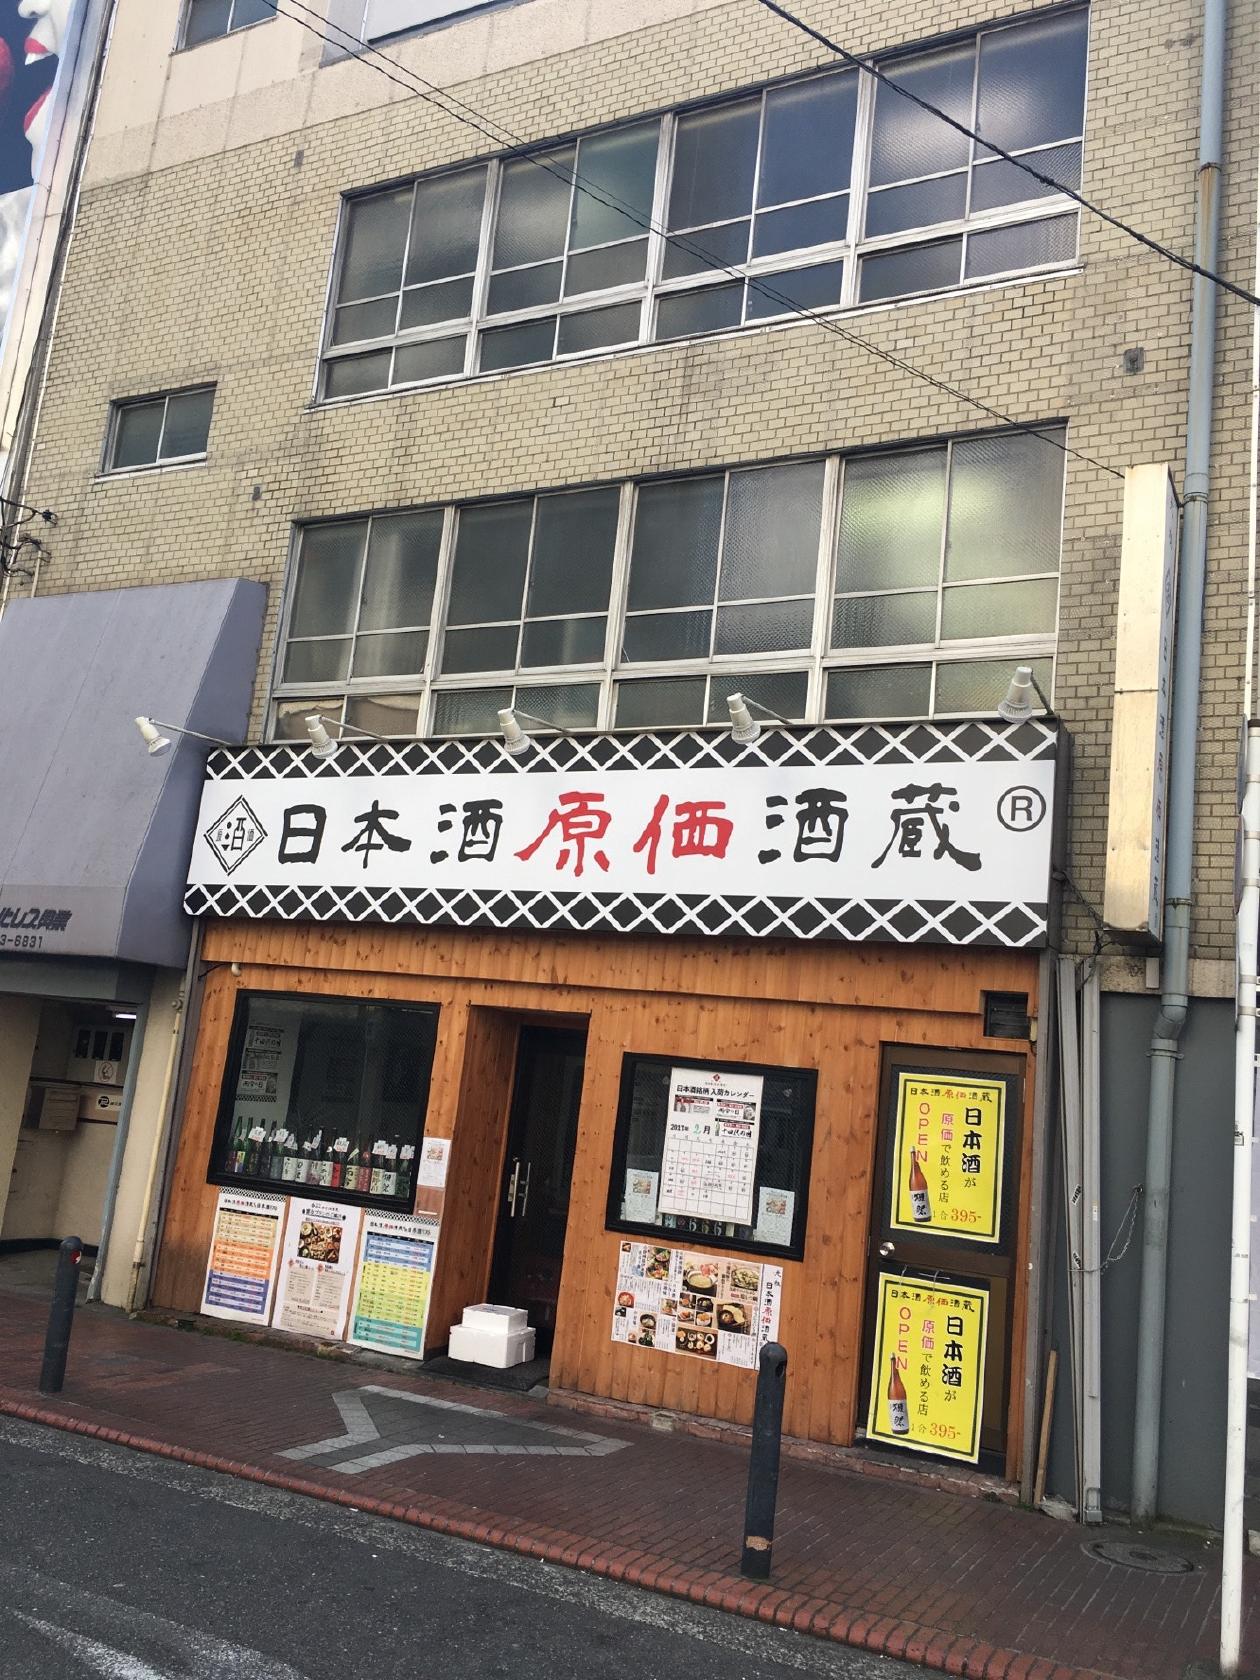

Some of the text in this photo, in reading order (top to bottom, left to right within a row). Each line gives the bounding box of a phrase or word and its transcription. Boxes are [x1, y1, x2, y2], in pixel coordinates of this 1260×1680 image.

[277, 782, 982, 877] 日本酒原価酒蔵
[910, 1087, 992, 1103] 日本酒原価酒蔵
[916, 1102, 931, 1164] OPEN
[938, 1113, 955, 1204] 原価で飲める店
[961, 1107, 983, 1188] 日本酒が
[891, 1289, 975, 1313] 日本酒原価酒蔵
[896, 1306, 912, 1370] OPEN
[917, 1319, 936, 1416] 原価で飲める店
[942, 1316, 964, 1402] 日本酒が
